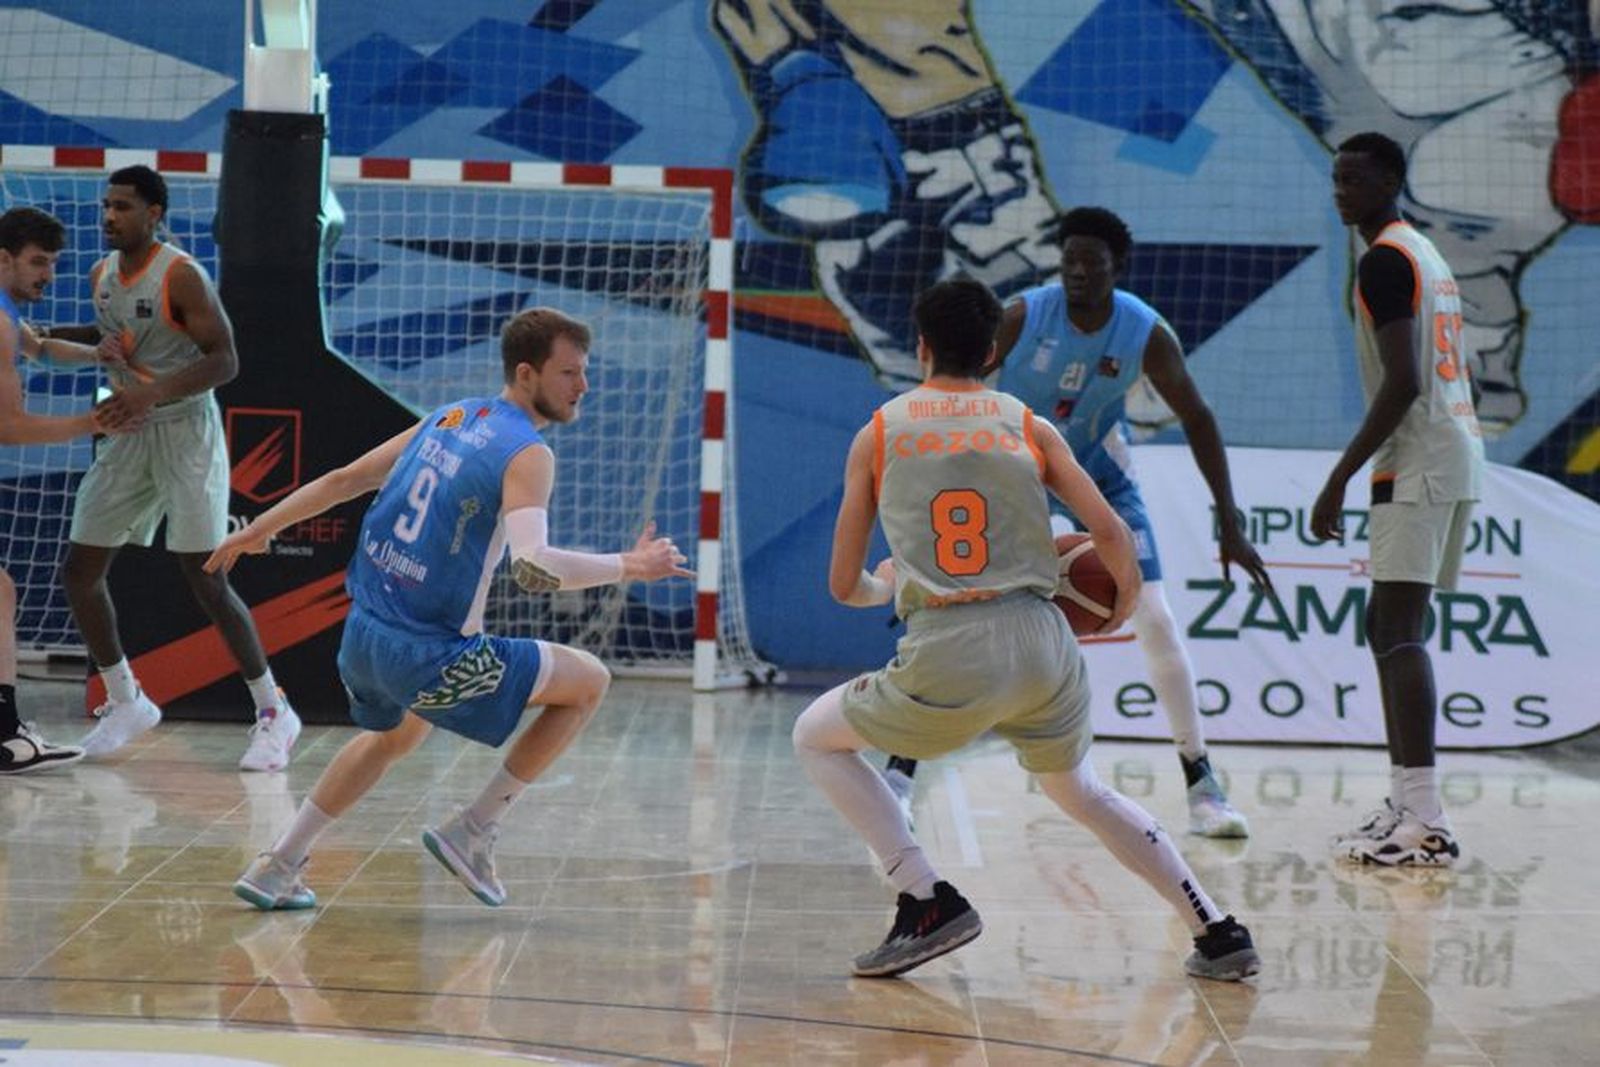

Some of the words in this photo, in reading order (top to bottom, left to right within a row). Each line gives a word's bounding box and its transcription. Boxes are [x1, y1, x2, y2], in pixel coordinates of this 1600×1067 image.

[908, 399, 1000, 420] QUEREJETA
[895, 429, 1020, 459] CAZOO
[393, 466, 438, 544] 9
[931, 488, 990, 577] 8
